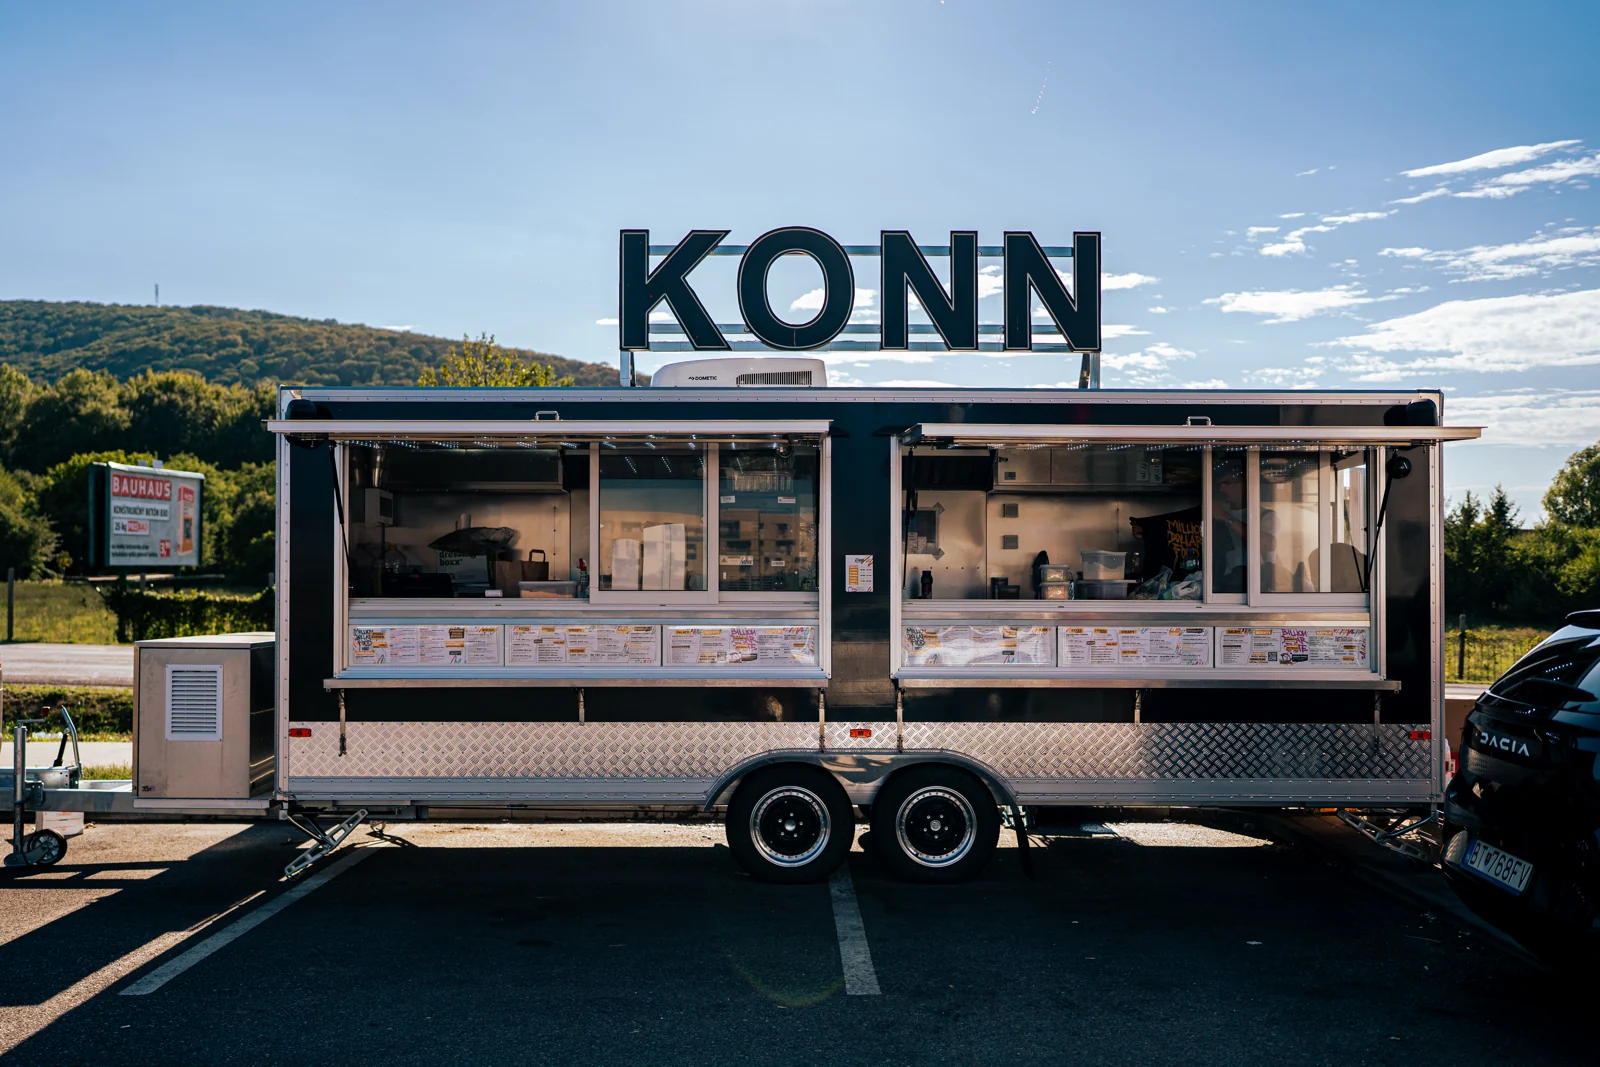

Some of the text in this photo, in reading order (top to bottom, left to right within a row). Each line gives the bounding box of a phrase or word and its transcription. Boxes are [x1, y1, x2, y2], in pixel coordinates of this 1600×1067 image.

[619, 226, 1101, 352] KONN
[112, 475, 171, 499] BAUHAUS
[1166, 520, 1201, 534] MILLIO
[1480, 732, 1529, 757] DACIA
[1470, 842, 1488, 868] BT
